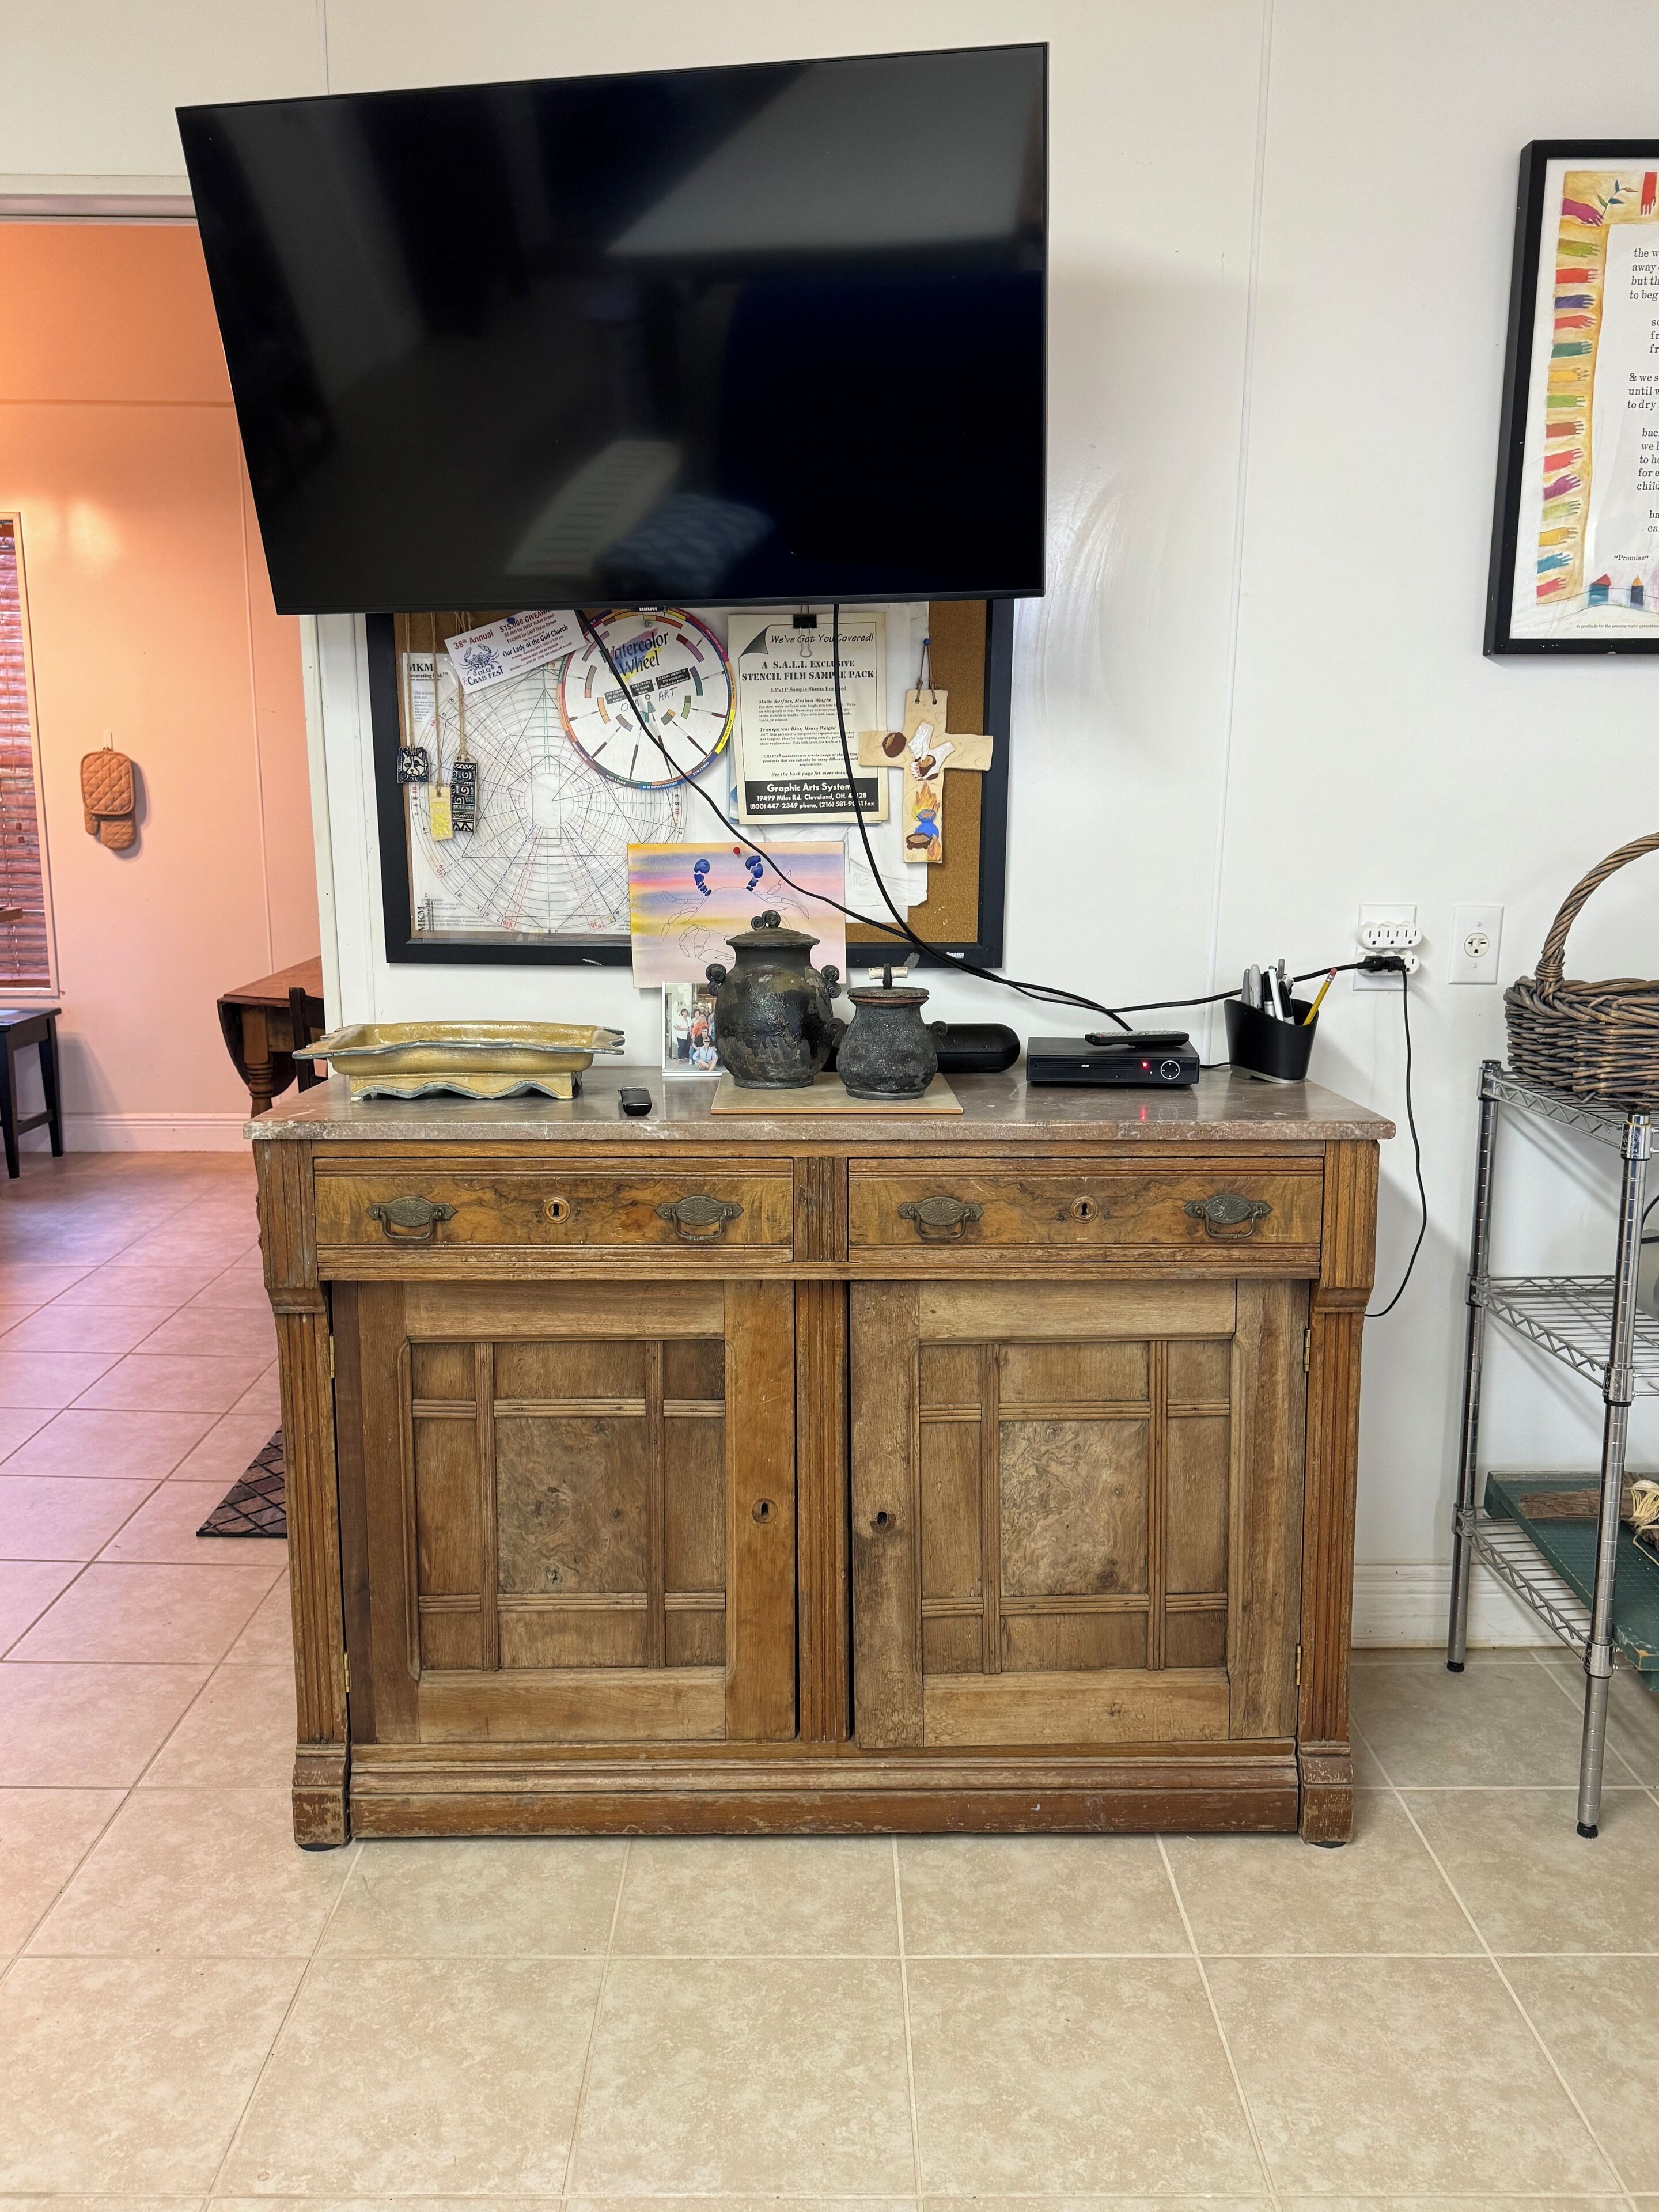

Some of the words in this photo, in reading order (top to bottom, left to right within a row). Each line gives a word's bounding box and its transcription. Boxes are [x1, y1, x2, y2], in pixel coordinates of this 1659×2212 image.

[1634, 248, 1649, 257] the
[1632, 264, 1657, 274] away
[1631, 275, 1647, 285] but
[1630, 290, 1639, 299] to
[1629, 372, 1637, 381] &
[1628, 386, 1653, 395] until
[1627, 399, 1637, 408] to
[1638, 399, 1657, 411] dry
[1642, 427, 1659, 437] bac
[1639, 455, 1649, 464] to
[1638, 468, 1653, 477] for
[469, 629, 494, 645] Annual
[502, 649, 512, 657] Our
[513, 644, 525, 653] Lady
[531, 638, 540, 646] the
[540, 632, 551, 642] Gulf
[551, 624, 569, 637] Church
[771, 635, 795, 644] We've
[797, 635, 815, 643] Got
[818, 634, 834, 642] You
[619, 650, 660, 676] Wheel
[467, 674, 487, 685] CRAB
[742, 673, 781, 681] STENCIL
[784, 672, 806, 680] FILM
[809, 671, 846, 679] SAMPE
[849, 670, 874, 679] PACK
[658, 686, 677, 702] ART
[767, 783, 801, 794] Graphic
[802, 783, 820, 791] Arts
[821, 782, 851, 793] System
[417, 906, 425, 932] MKM
